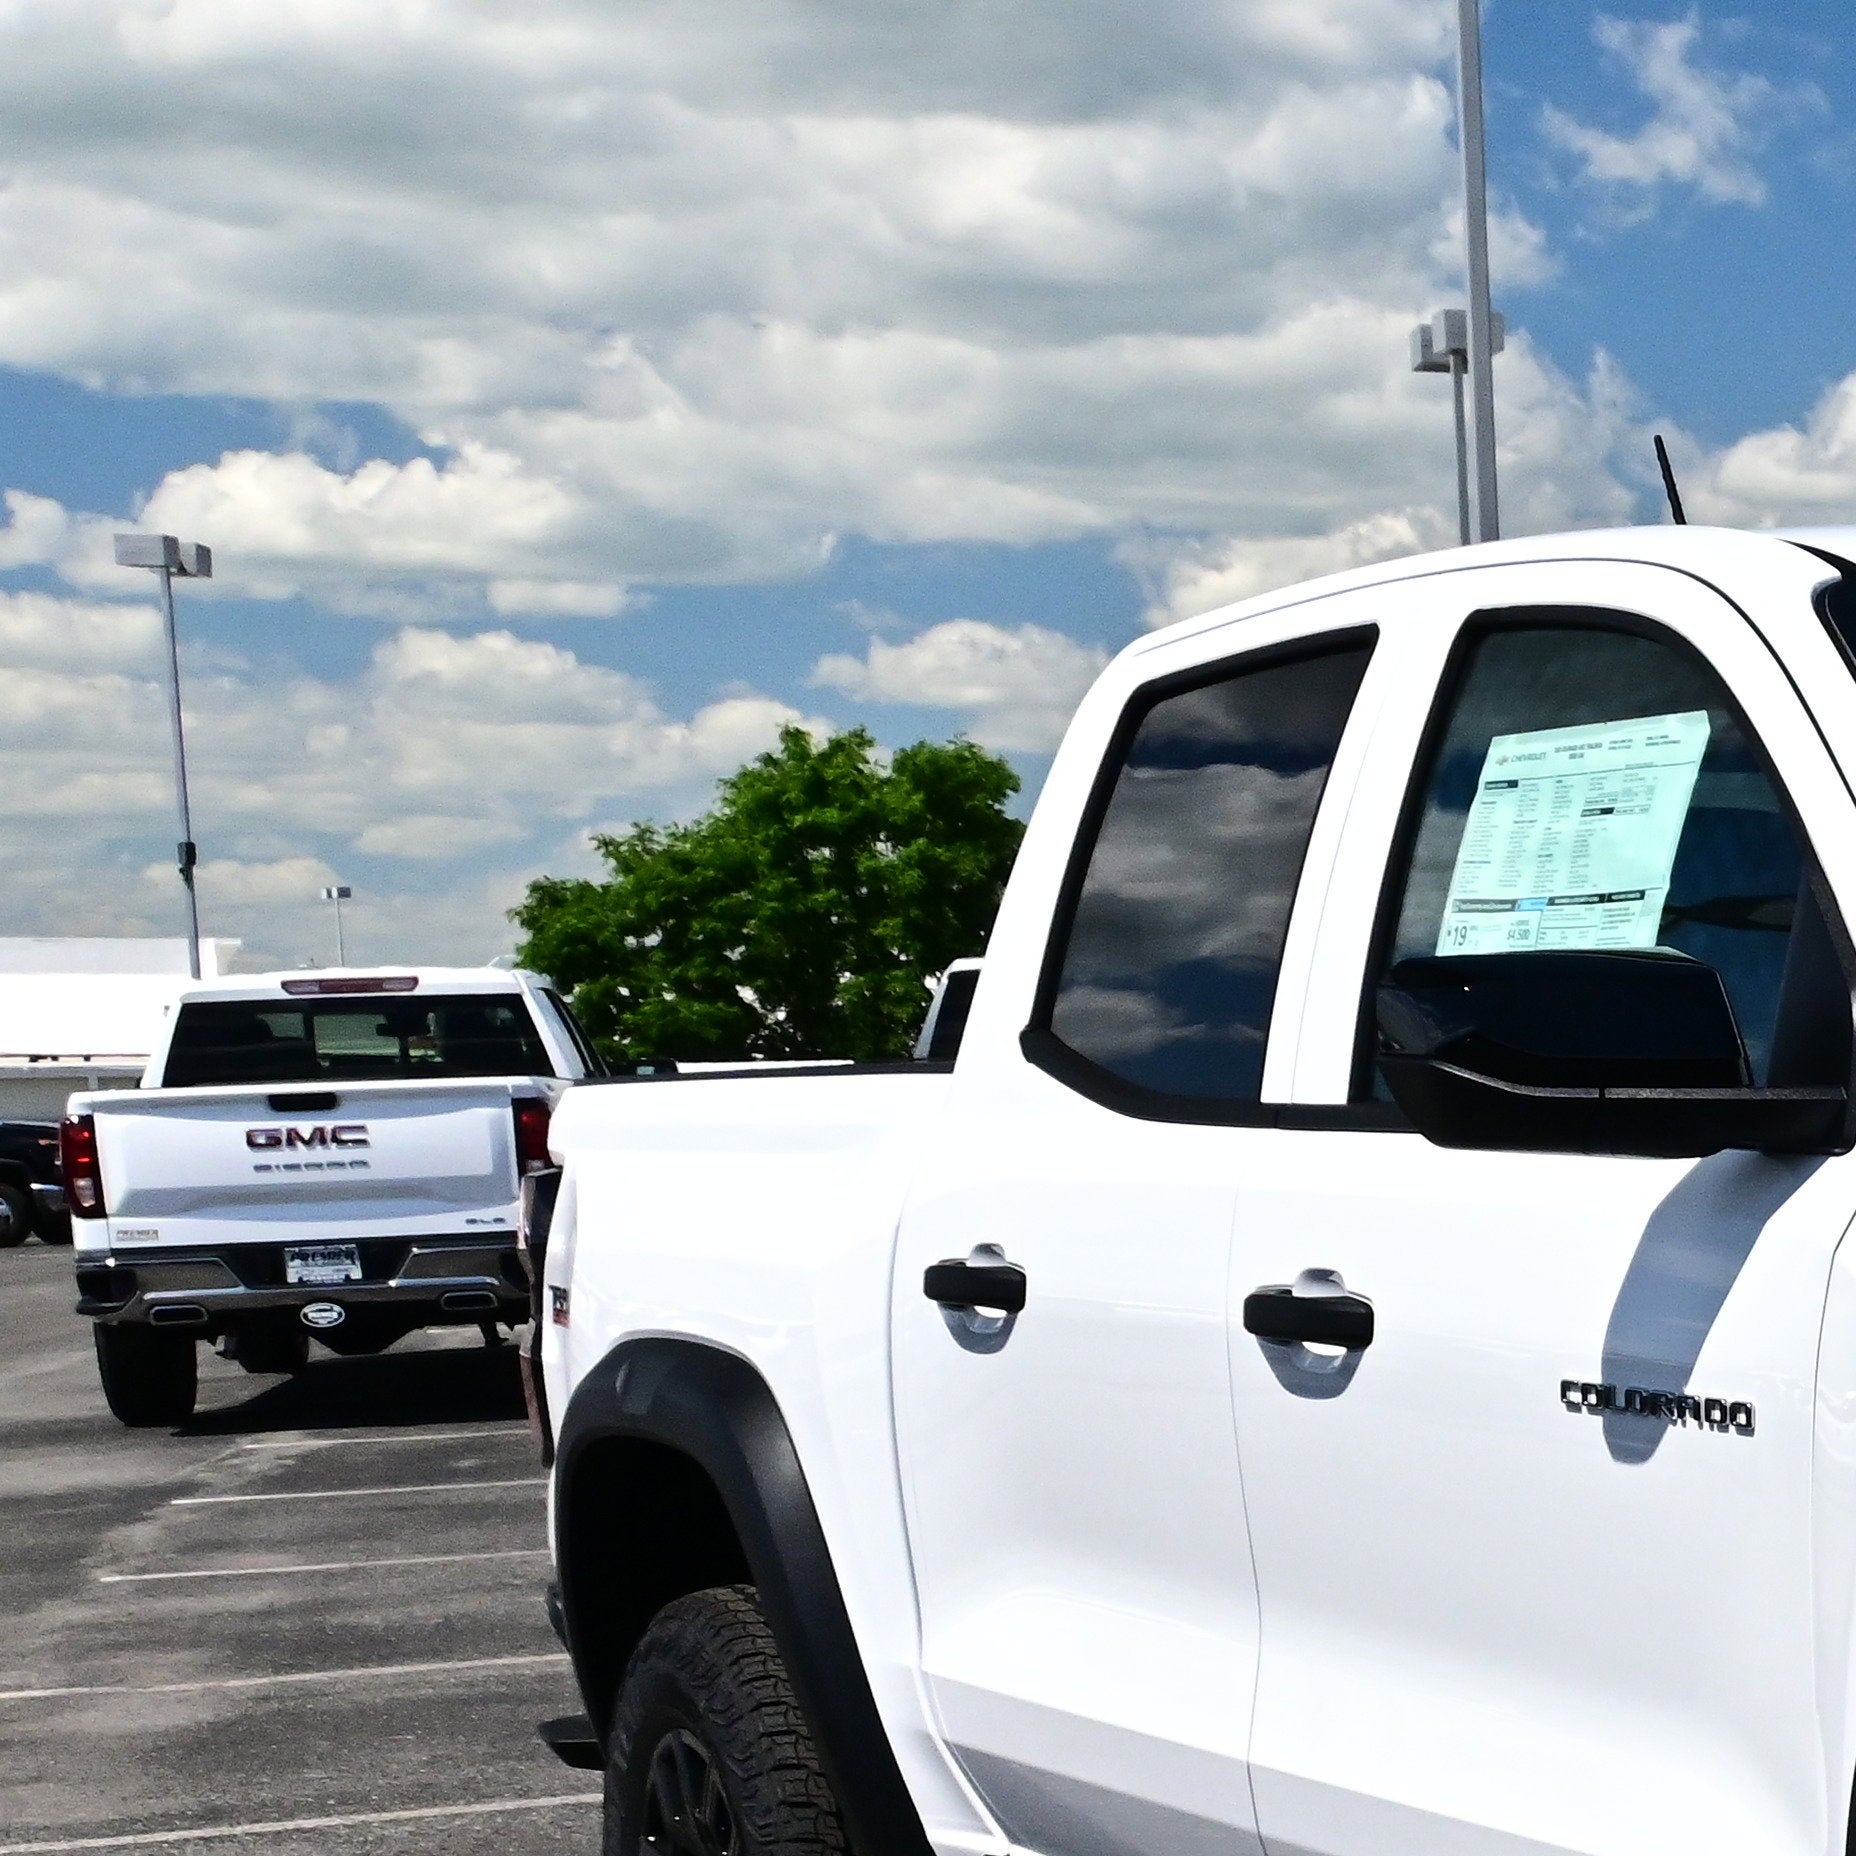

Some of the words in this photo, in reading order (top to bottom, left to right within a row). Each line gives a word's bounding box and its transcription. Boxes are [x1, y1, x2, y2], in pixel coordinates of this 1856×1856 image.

[1510, 751, 1548, 764] CHEVROLET
[1453, 925, 1468, 947] 19
[246, 1124, 370, 1152] GMC
[1560, 1379, 1755, 1430] COLORADO
